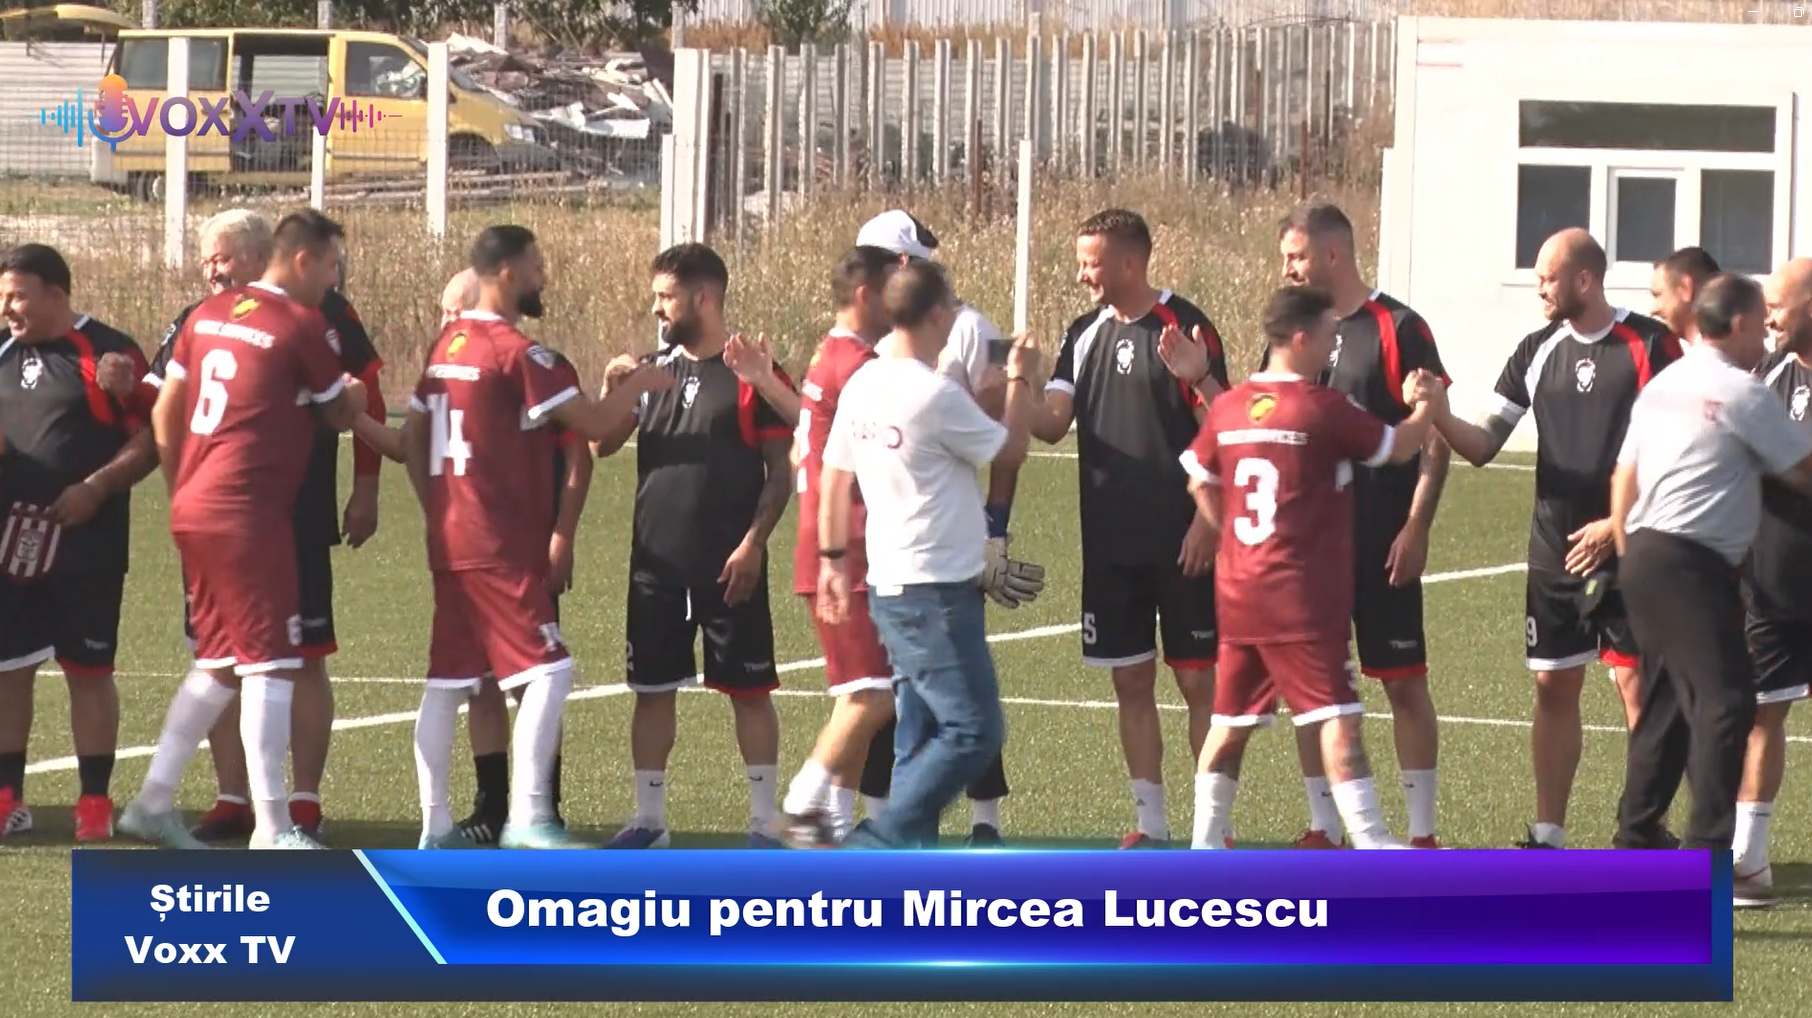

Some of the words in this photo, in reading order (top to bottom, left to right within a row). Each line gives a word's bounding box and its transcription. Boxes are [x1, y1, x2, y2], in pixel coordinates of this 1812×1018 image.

[190, 349, 238, 434] 6
[427, 393, 473, 476] 14
[1233, 457, 1279, 546] 3
[1526, 616, 1539, 647] 9
